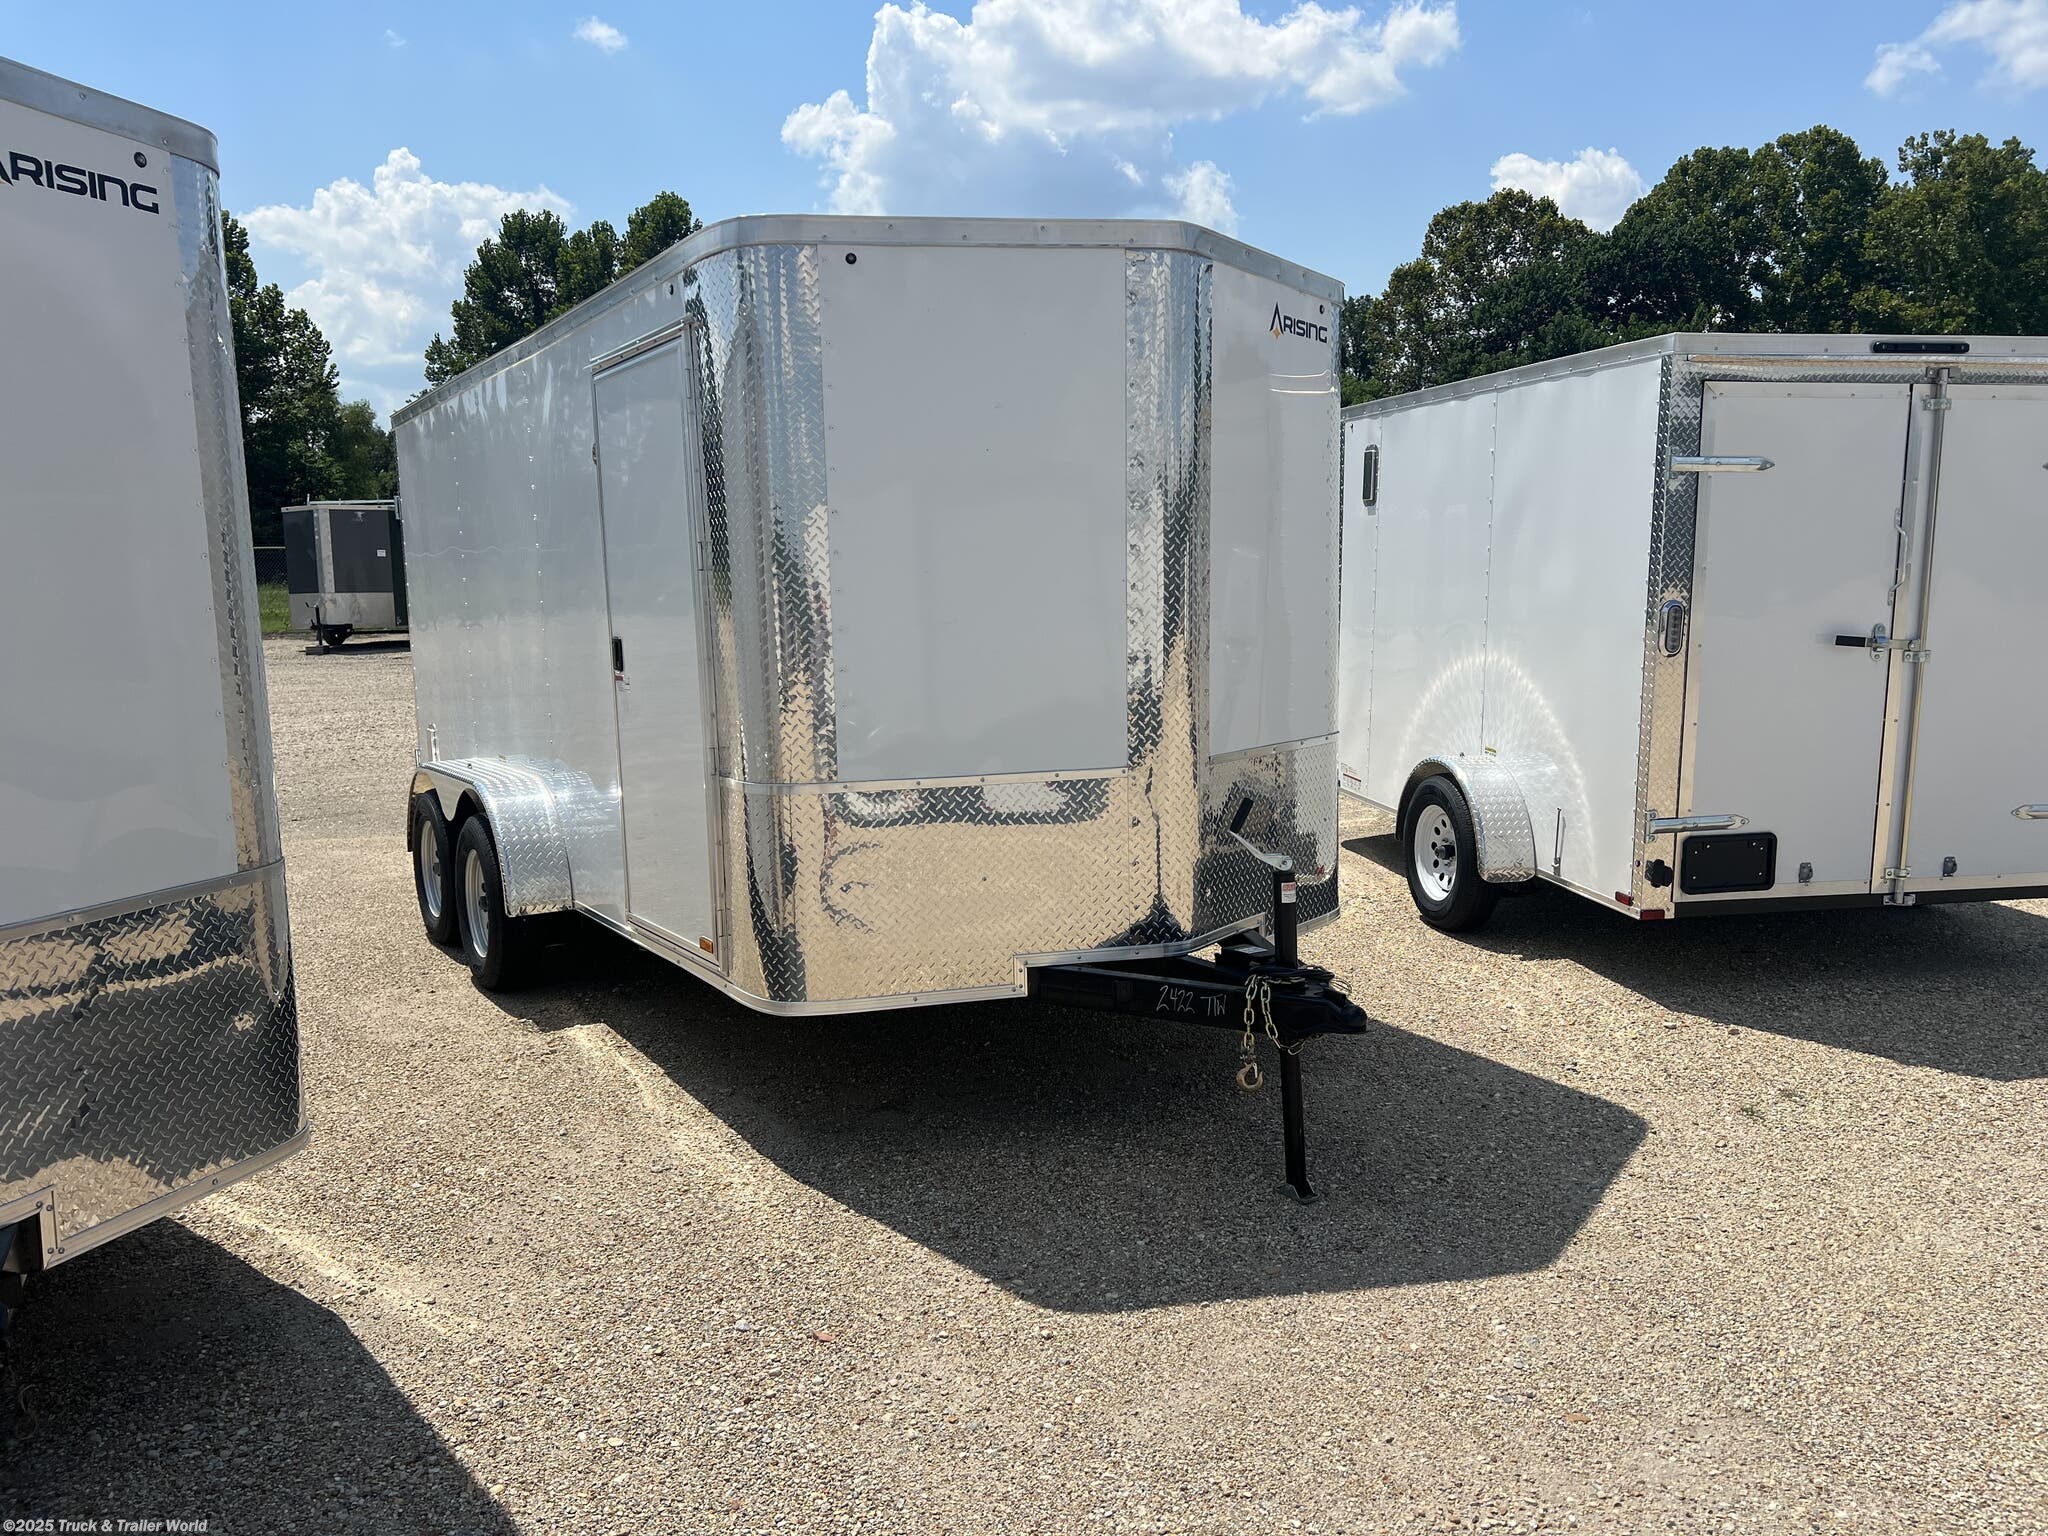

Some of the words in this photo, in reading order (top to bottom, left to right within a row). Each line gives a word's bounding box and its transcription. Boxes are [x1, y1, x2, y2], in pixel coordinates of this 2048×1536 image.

[0, 150, 160, 215] RISING
[1269, 301, 1328, 344] ARISING
[1156, 984, 1196, 1014] 2422
